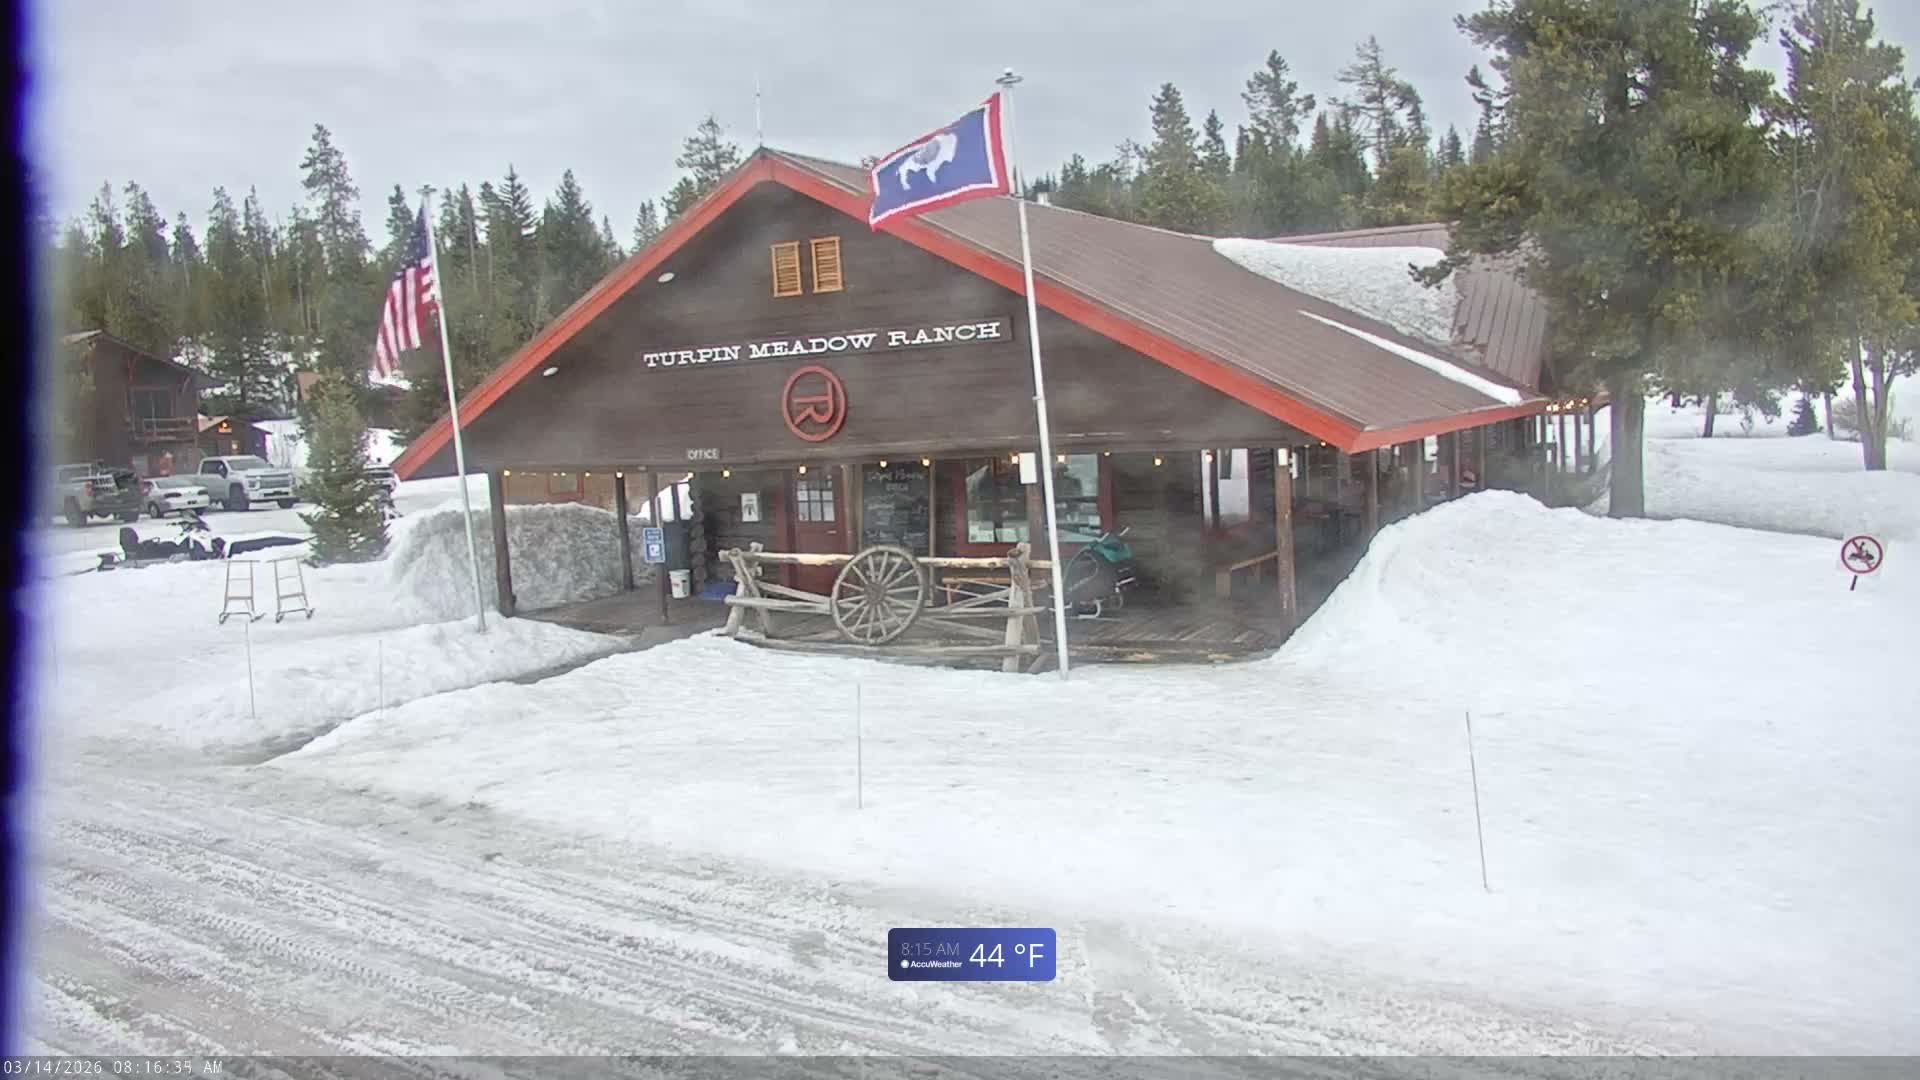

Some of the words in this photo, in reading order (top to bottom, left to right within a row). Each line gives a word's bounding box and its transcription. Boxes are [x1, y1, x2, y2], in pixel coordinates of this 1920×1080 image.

[643, 346, 740, 368] TURPIN
[749, 333, 877, 360] MEADOW
[887, 321, 1001, 347] RANCH
[687, 448, 719, 461] OFFICE
